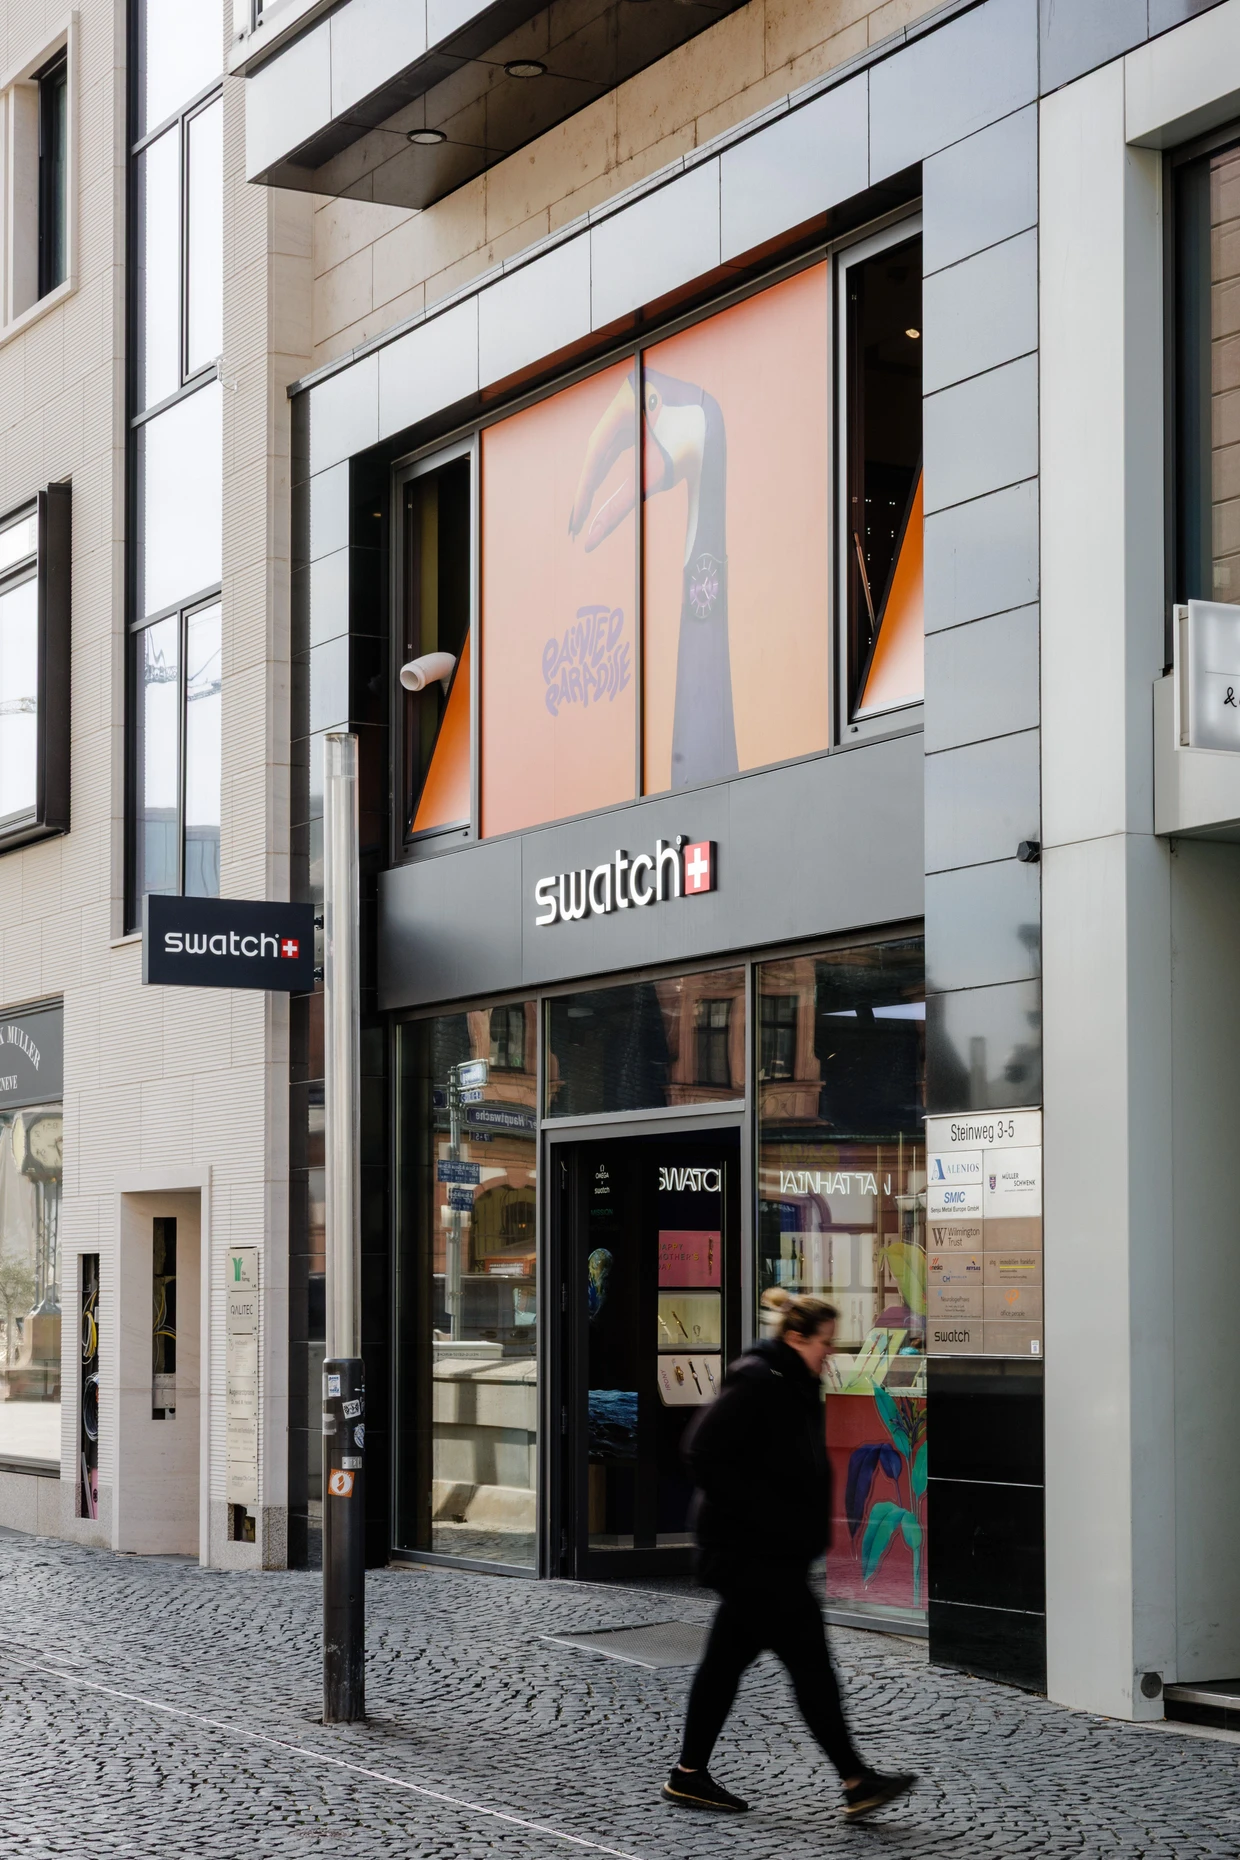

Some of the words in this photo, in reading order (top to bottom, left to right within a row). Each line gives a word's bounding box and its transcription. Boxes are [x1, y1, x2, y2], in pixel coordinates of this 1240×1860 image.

[535, 838, 684, 927] swatch
[164, 931, 279, 958] swatch
[7, 1025, 41, 1071] MULLER
[0, 1075, 18, 1091] NEVE
[951, 1123, 994, 1143] Steinweg
[997, 1120, 1015, 1139] 3-5
[946, 1163, 980, 1174] ALENIOS
[659, 1167, 721, 1192] SWATC
[944, 1191, 966, 1204] SMIC
[948, 1227, 980, 1238] Wilmington
[948, 1237, 963, 1247] Trust
[934, 1329, 970, 1343] swatch
